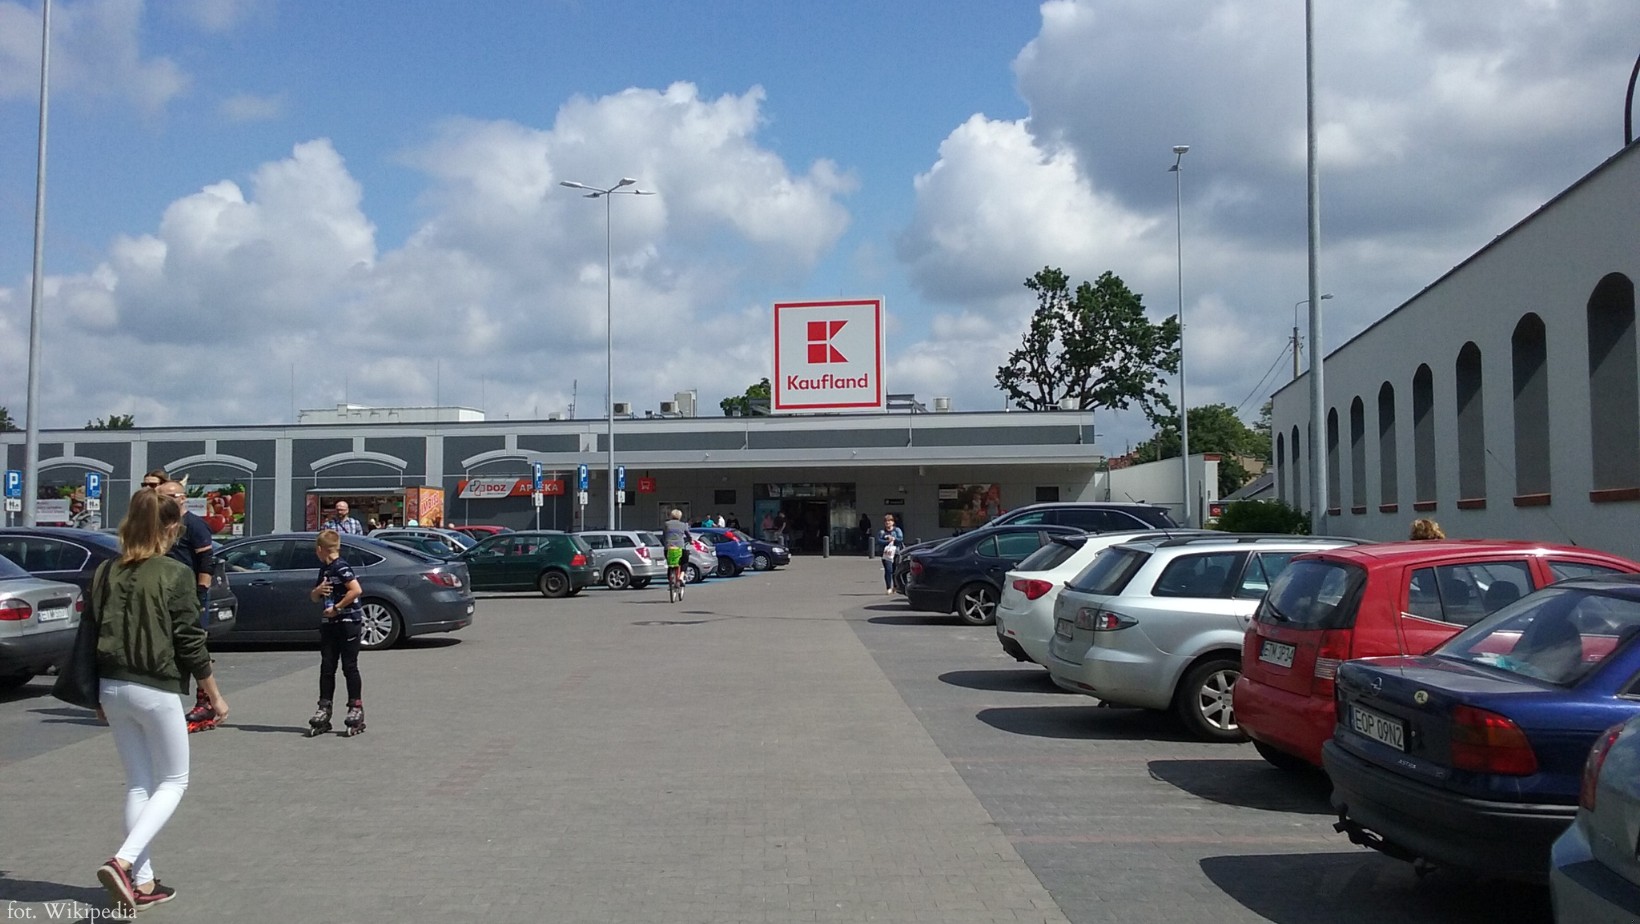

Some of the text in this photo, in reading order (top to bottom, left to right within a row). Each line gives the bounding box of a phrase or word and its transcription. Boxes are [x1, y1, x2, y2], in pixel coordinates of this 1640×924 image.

[787, 372, 869, 391] Kaufland
[9, 472, 19, 489] P
[581, 465, 587, 481] P
[90, 475, 99, 490] P
[486, 484, 507, 492] DOZ
[1355, 709, 1403, 748] EOP 09N2
